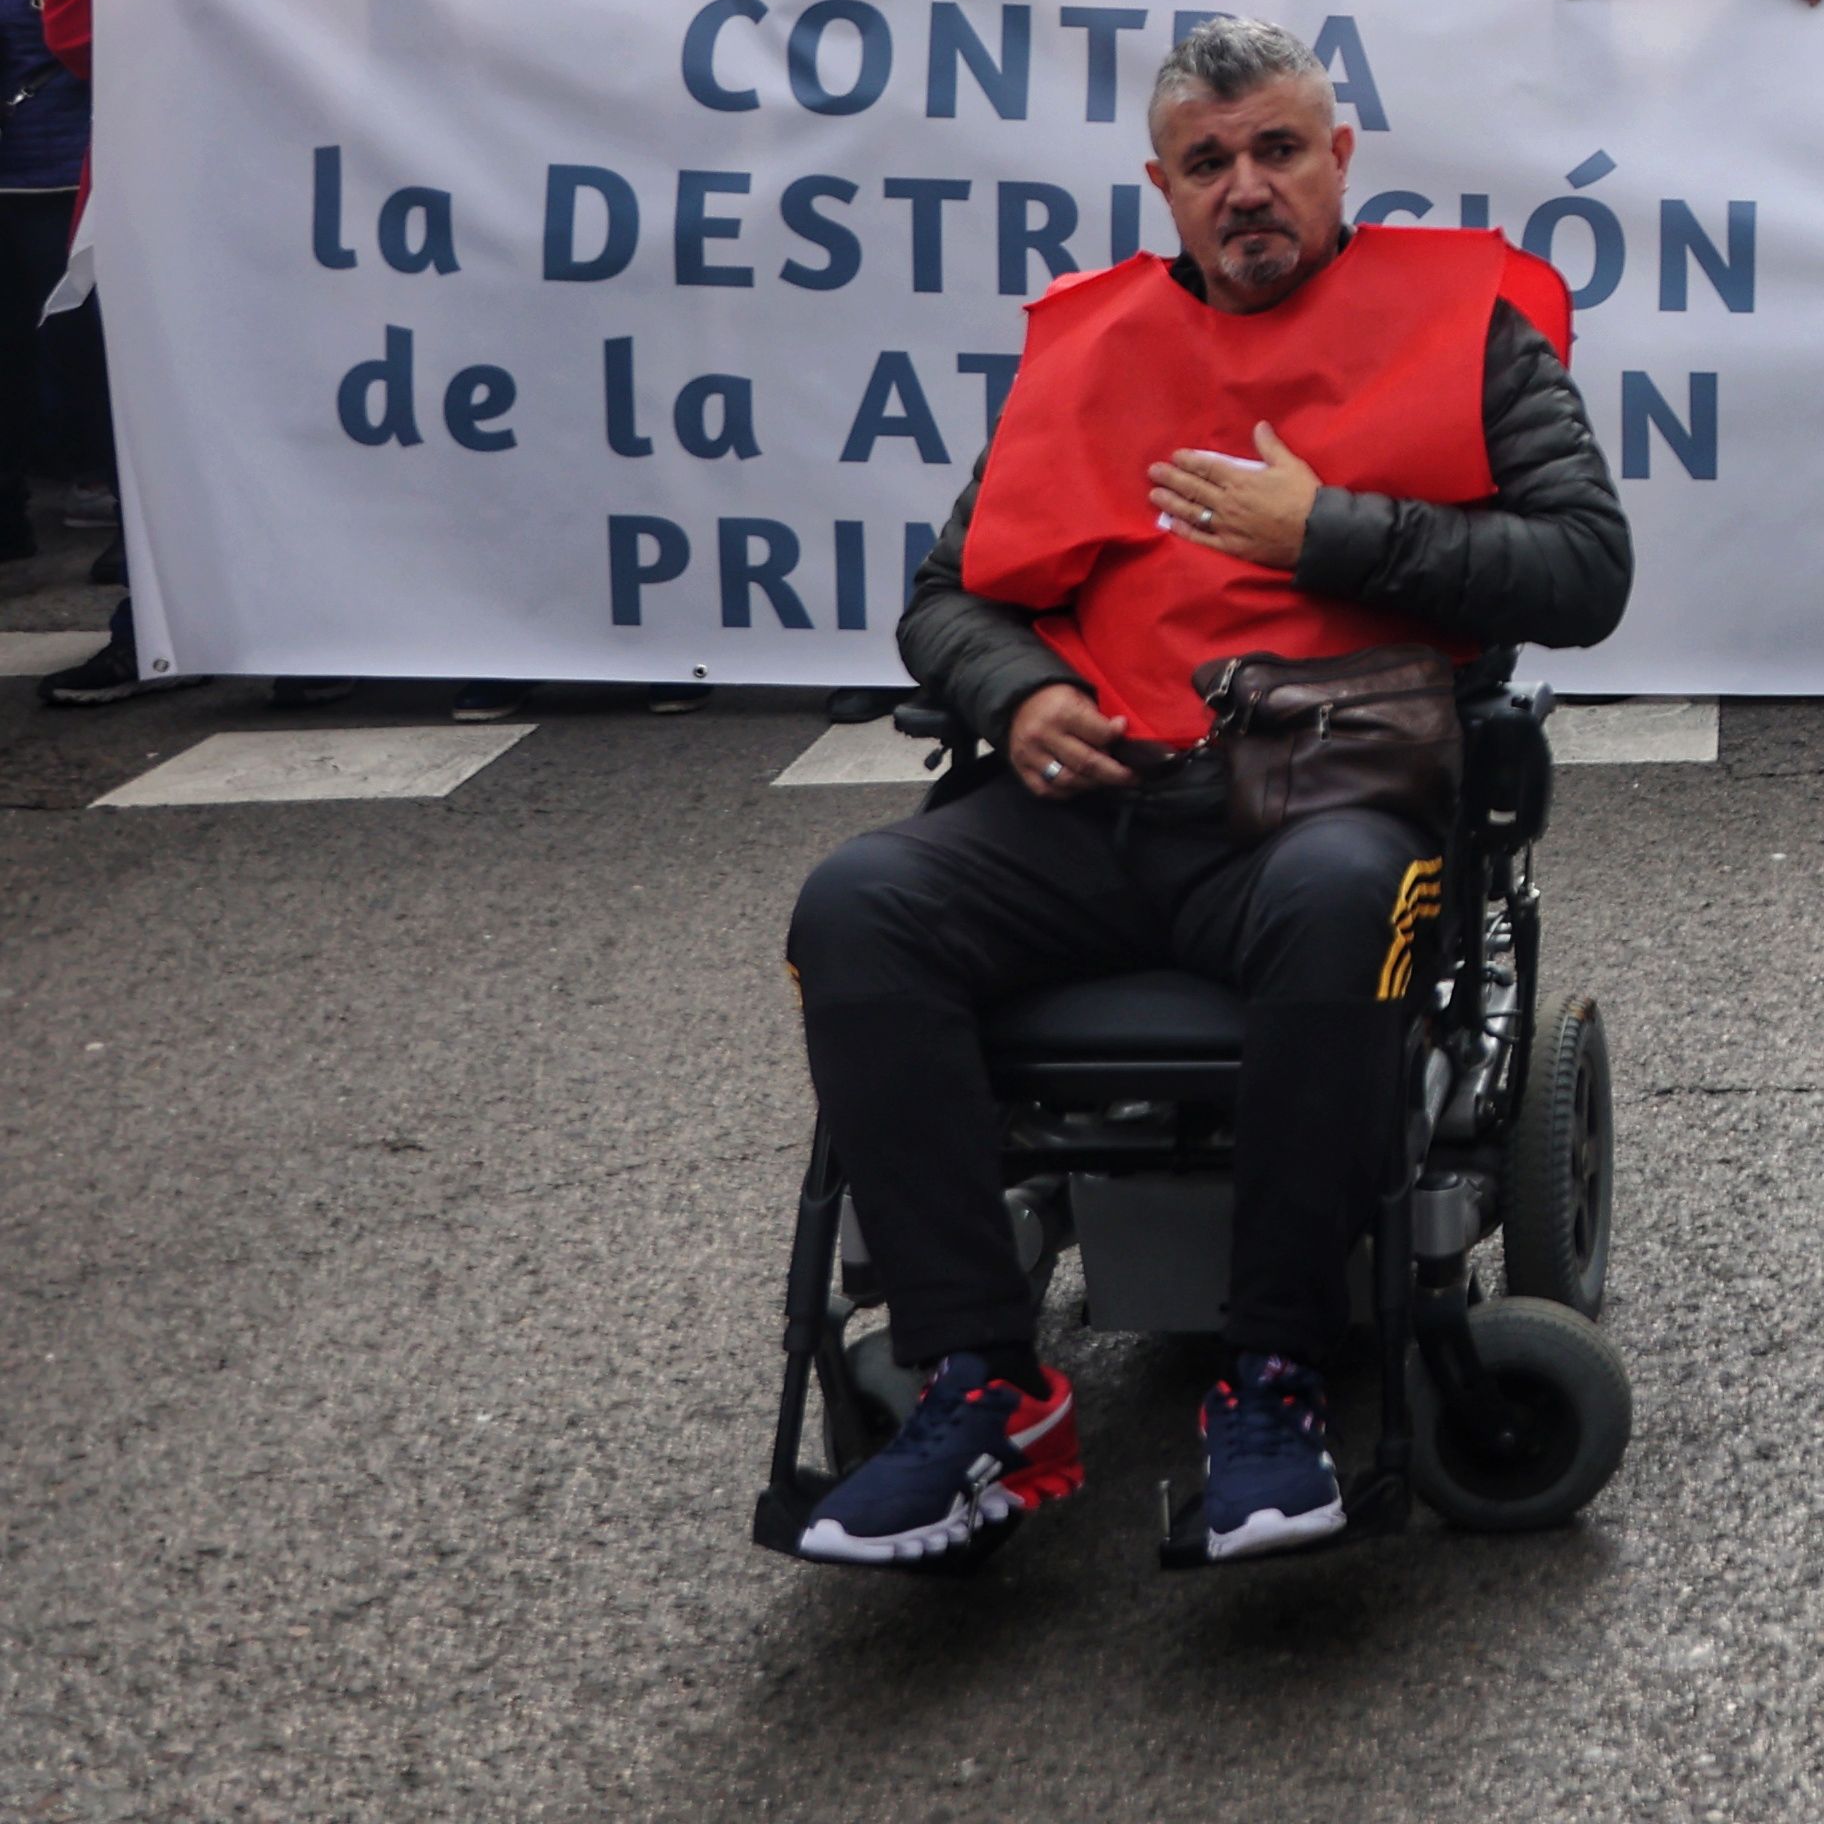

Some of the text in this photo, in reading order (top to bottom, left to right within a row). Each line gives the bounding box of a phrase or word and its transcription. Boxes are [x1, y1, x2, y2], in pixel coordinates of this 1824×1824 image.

[312, 144, 462, 277] la
[337, 325, 518, 453] de
[603, 336, 763, 462] la
